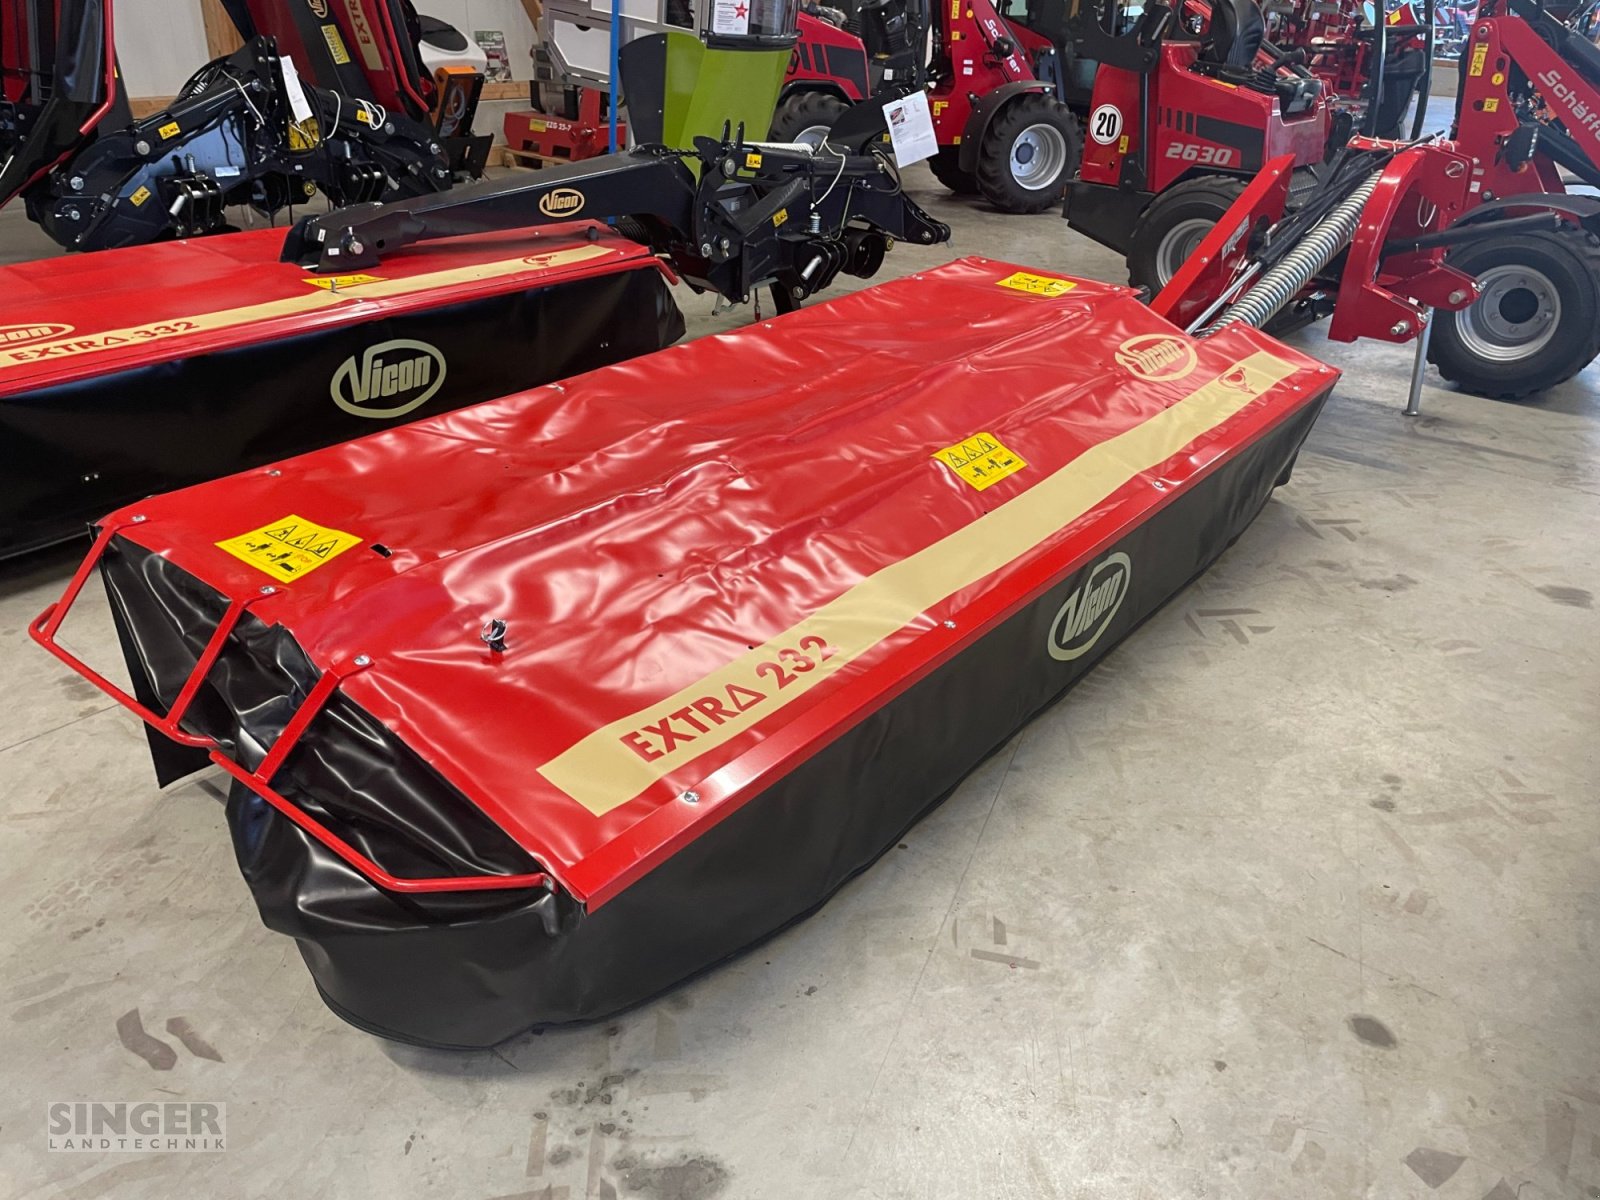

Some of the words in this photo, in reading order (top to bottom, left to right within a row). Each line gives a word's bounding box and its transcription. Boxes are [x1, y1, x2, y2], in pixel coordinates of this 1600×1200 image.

[1096, 112, 1117, 138] 20
[1165, 142, 1232, 165] 2630
[543, 190, 580, 212] Vicon
[133, 321, 200, 338] 332
[1117, 337, 1189, 376] Vicon
[340, 345, 432, 404] Vicon
[1058, 563, 1126, 648] Vicon
[755, 635, 840, 690] 232
